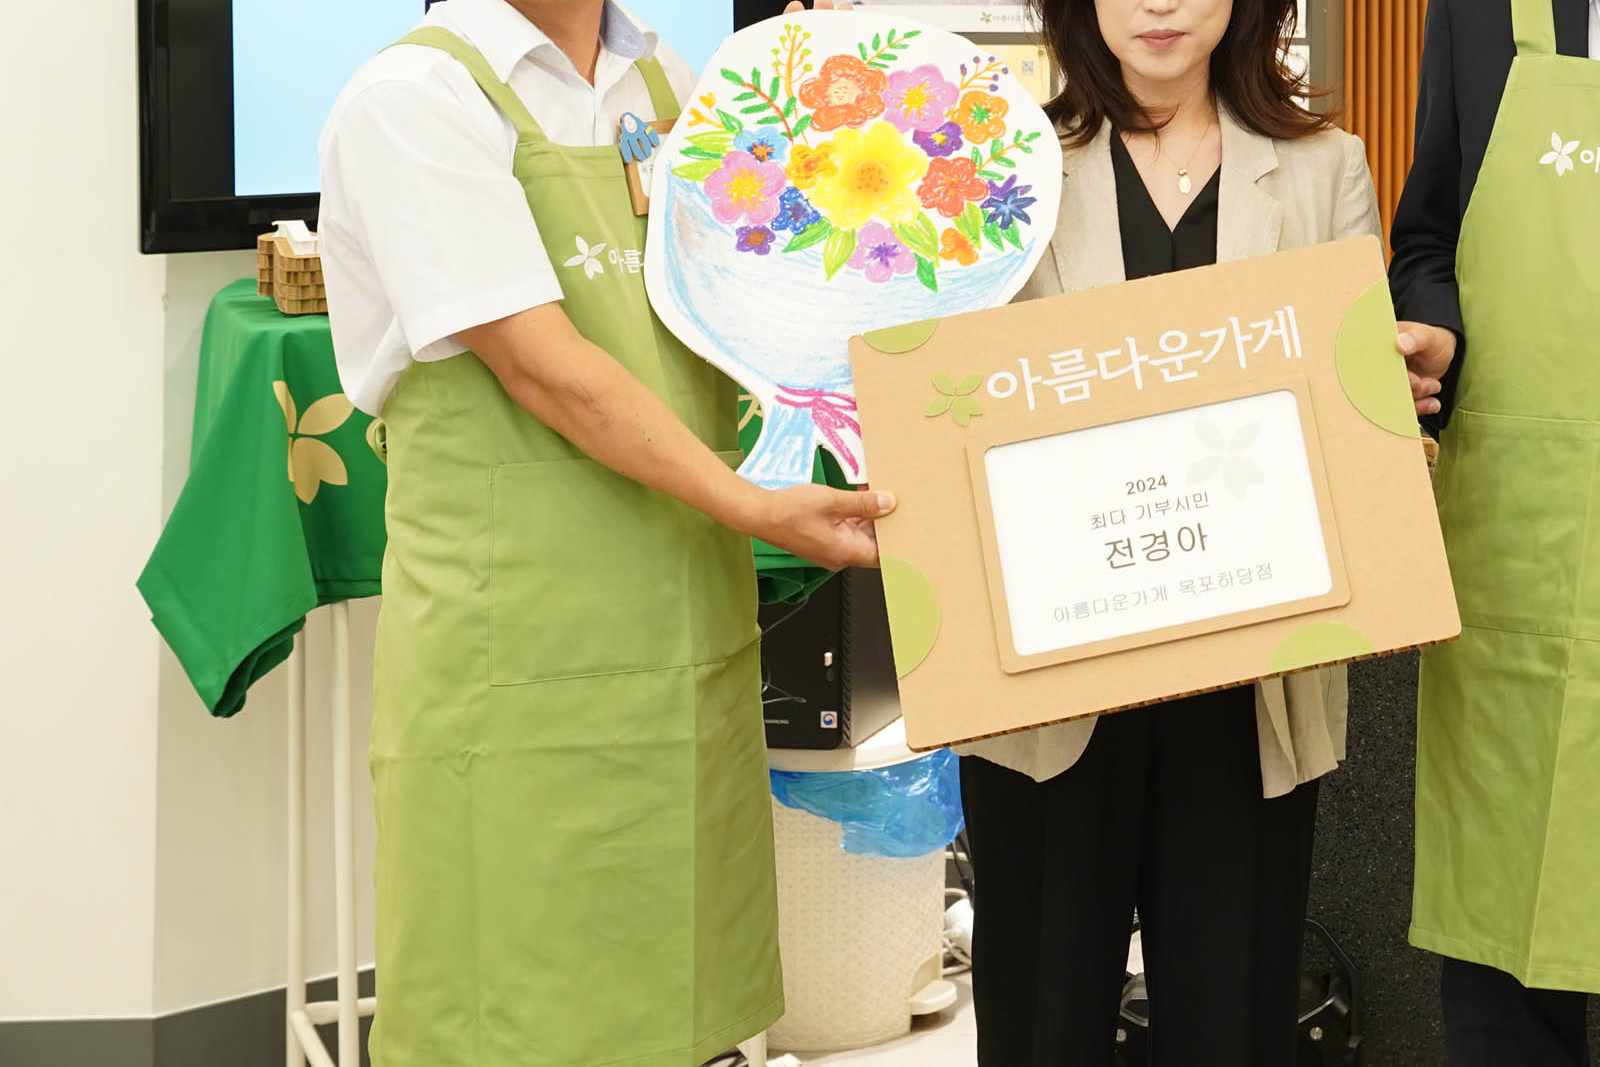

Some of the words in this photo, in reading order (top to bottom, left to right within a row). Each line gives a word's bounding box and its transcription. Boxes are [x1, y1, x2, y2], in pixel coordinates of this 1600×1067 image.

[987, 305, 1302, 411] 아름다운가게
[1125, 475, 1168, 495] 2024
[1090, 509, 1127, 530] 최다
[1136, 490, 1210, 520] 기부시민
[1105, 522, 1208, 569] 전경아
[1053, 585, 1168, 624] 아름다운가게
[1178, 562, 1274, 596] 목포하당점
